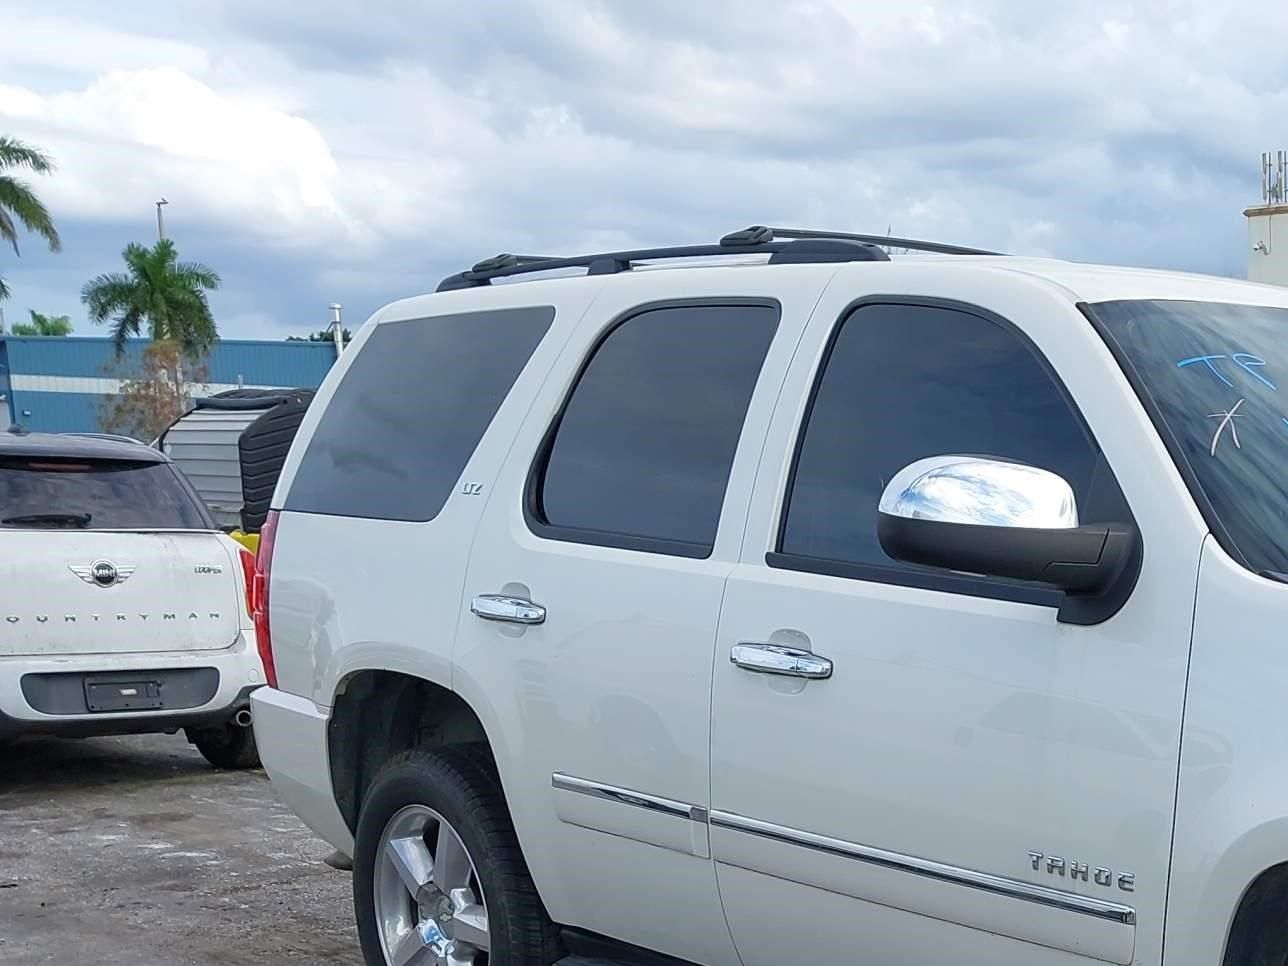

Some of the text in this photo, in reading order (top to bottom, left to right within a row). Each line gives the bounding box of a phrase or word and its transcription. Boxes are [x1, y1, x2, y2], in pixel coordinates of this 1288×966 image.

[461, 482, 483, 496] LTZ
[94, 568, 116, 578] MINI
[5, 612, 220, 623] OUNTRYMAN
[1027, 850, 1135, 892] TAHOE
